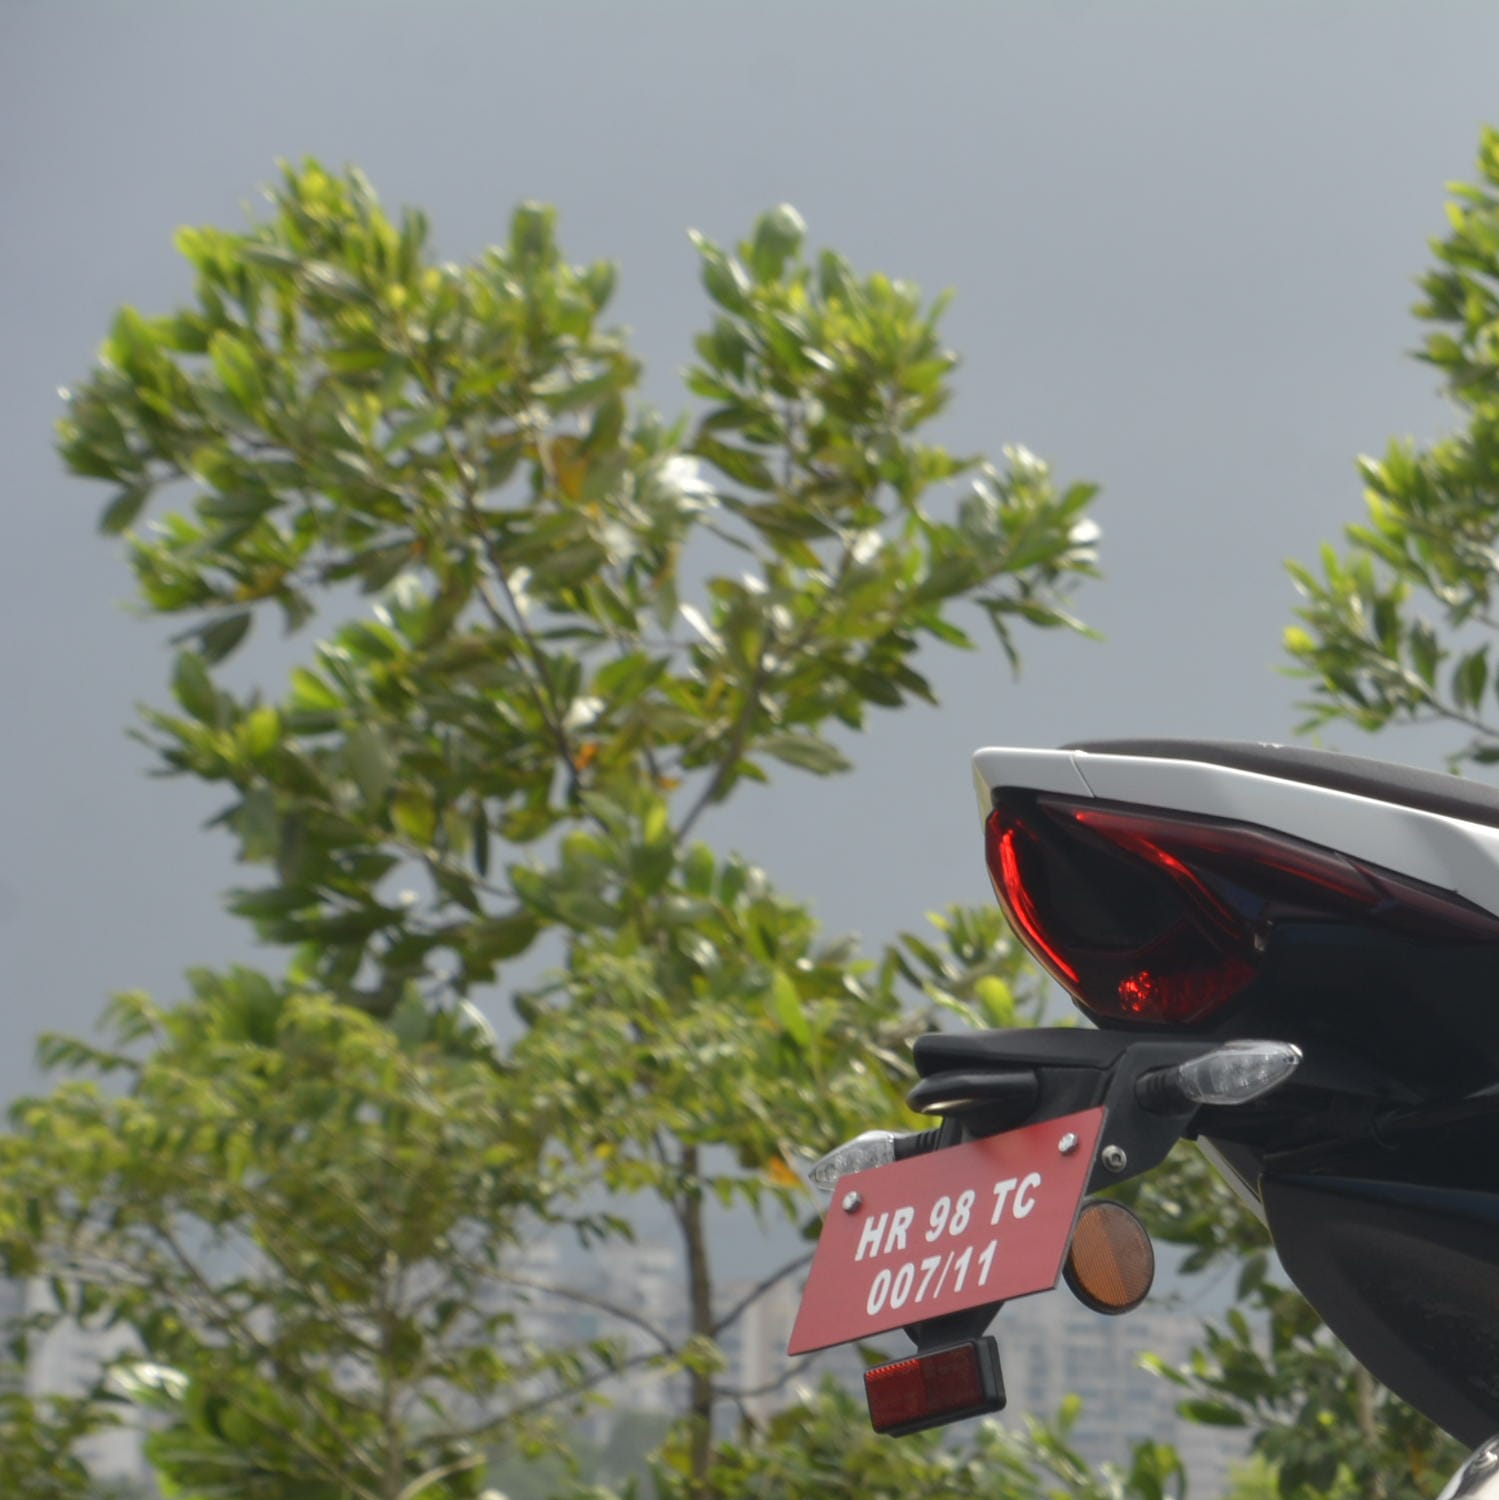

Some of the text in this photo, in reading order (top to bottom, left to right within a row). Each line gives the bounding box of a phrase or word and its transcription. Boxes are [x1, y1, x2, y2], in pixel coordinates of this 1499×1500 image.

[855, 1172, 1041, 1262] HR 98 TC
[866, 1240, 997, 1316] 007/11
